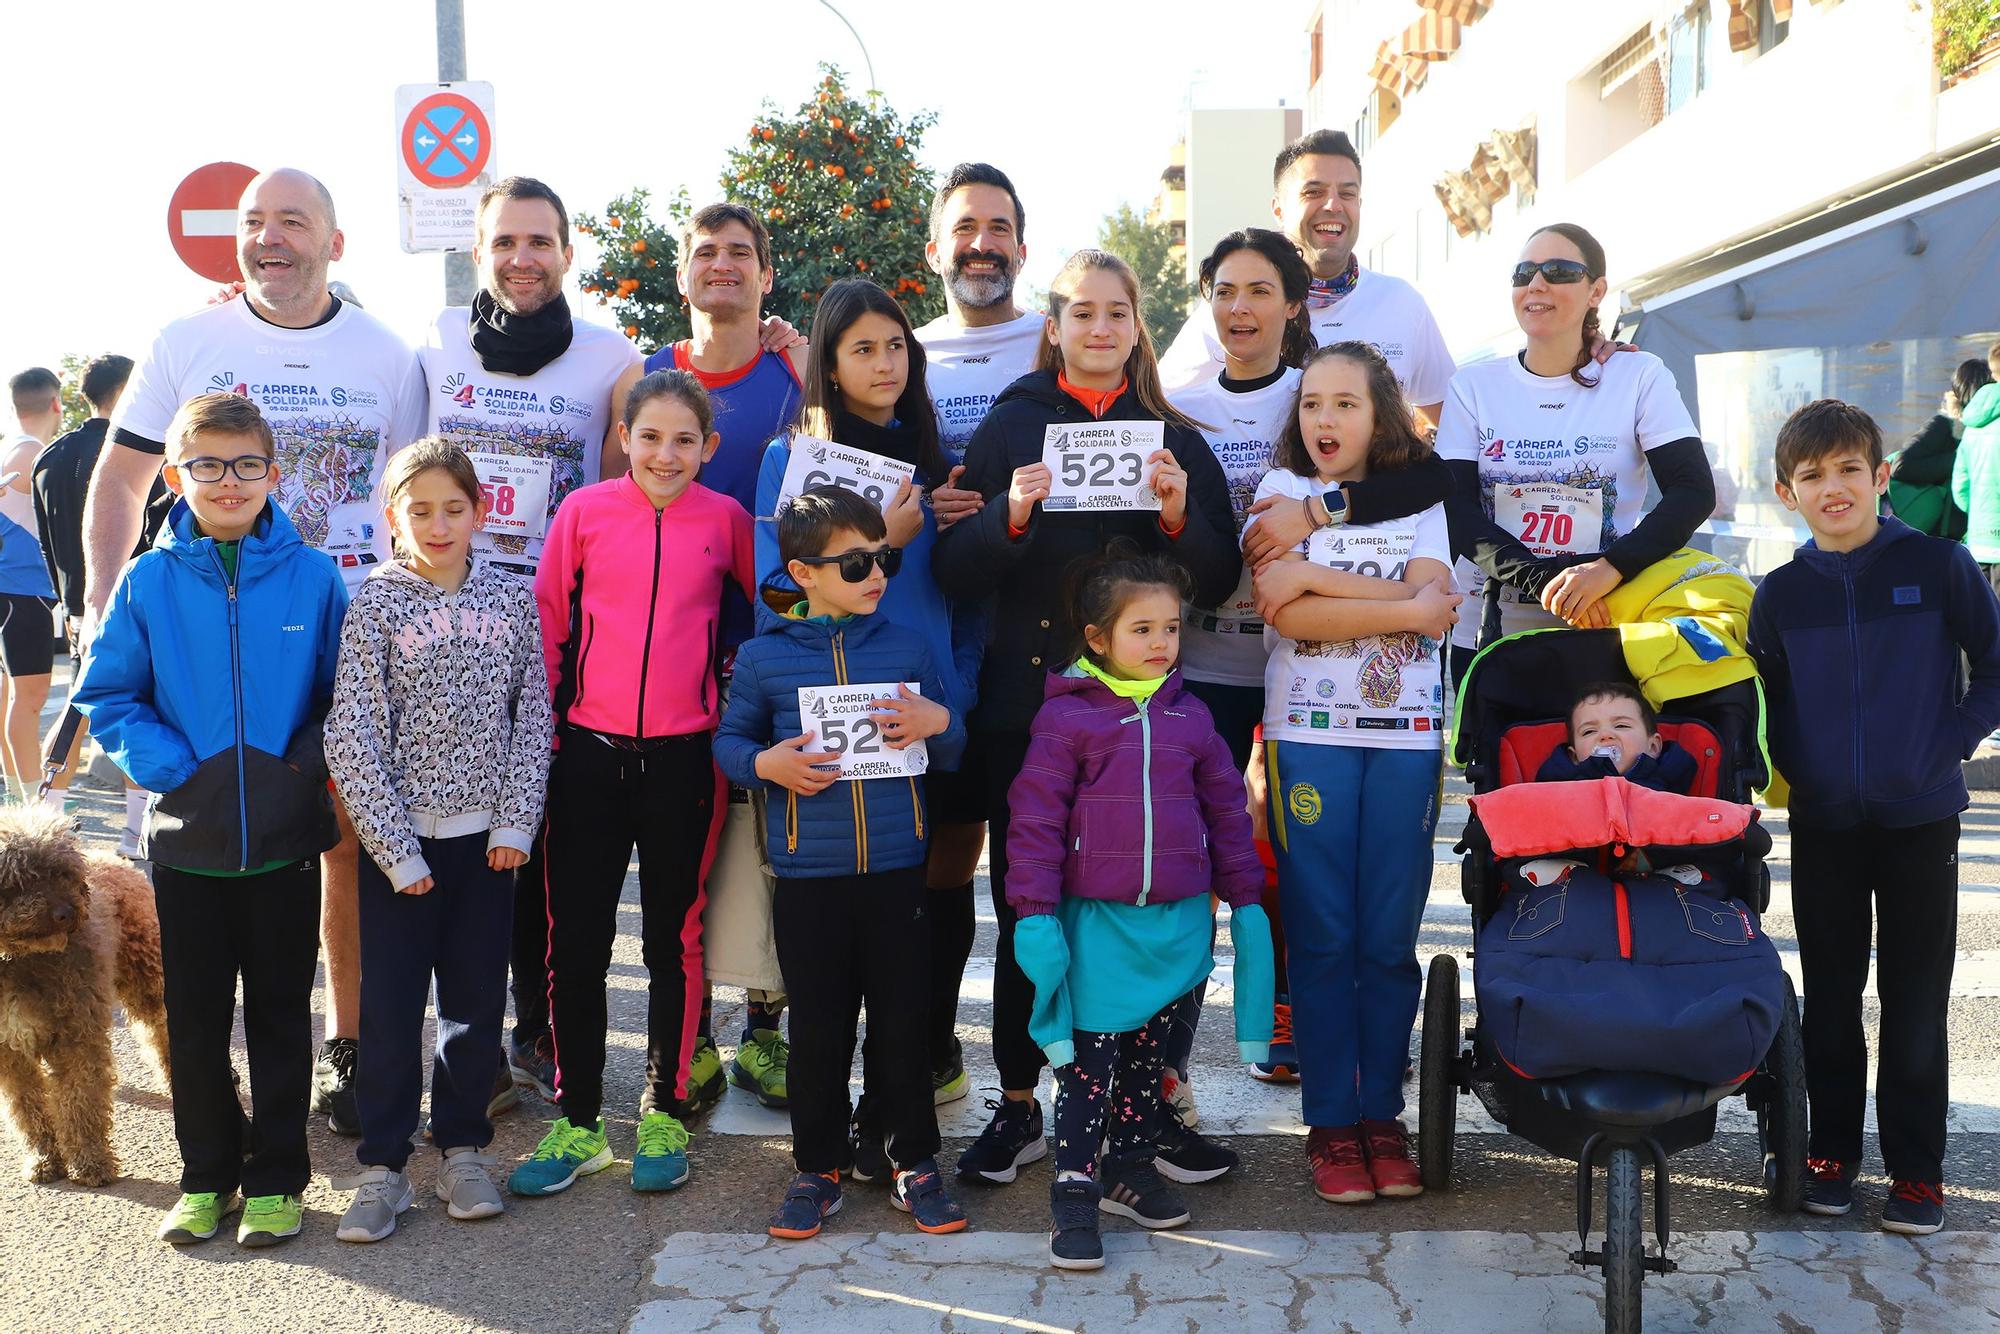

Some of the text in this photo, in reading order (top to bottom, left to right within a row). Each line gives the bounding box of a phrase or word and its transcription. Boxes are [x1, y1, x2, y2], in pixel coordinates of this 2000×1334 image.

[250, 384, 319, 396] CARRERA
[452, 383, 538, 409] 4 CARRERA
[262, 395, 330, 407] SOLIDARIA
[483, 397, 546, 414] SOLIDARIA
[936, 394, 996, 408] CARRERA
[1053, 429, 1115, 453] 4 CARRERA
[1074, 439, 1118, 448] SOLIDARIA
[1212, 440, 1271, 453] CARRERA
[1484, 438, 1564, 462] 4 CARRERA
[1514, 448, 1572, 460] SOLIDARIA
[473, 456, 510, 466] CARRERA
[811, 446, 870, 468] 4 CARRERA
[497, 465, 540, 475] SOLIDARIA
[883, 460, 913, 474] PRIMARIA
[1061, 452, 1143, 488] 523
[855, 466, 901, 486] SOLIDARIA
[1087, 494, 1122, 502] CARRERA
[1510, 487, 1524, 499] 4
[1550, 494, 1590, 505] SOLIDARIA
[1078, 500, 1133, 508] ADOLESCENTES
[1519, 511, 1574, 546] 270
[1332, 537, 1389, 555] 4 CARRERA
[810, 693, 876, 719] 4 CARRERA
[832, 702, 880, 715] SOLIDARIA
[853, 761, 891, 770] CARRERA
[842, 767, 902, 778] ADOLESCENTES
[1291, 783, 1314, 794] COLEGIO
